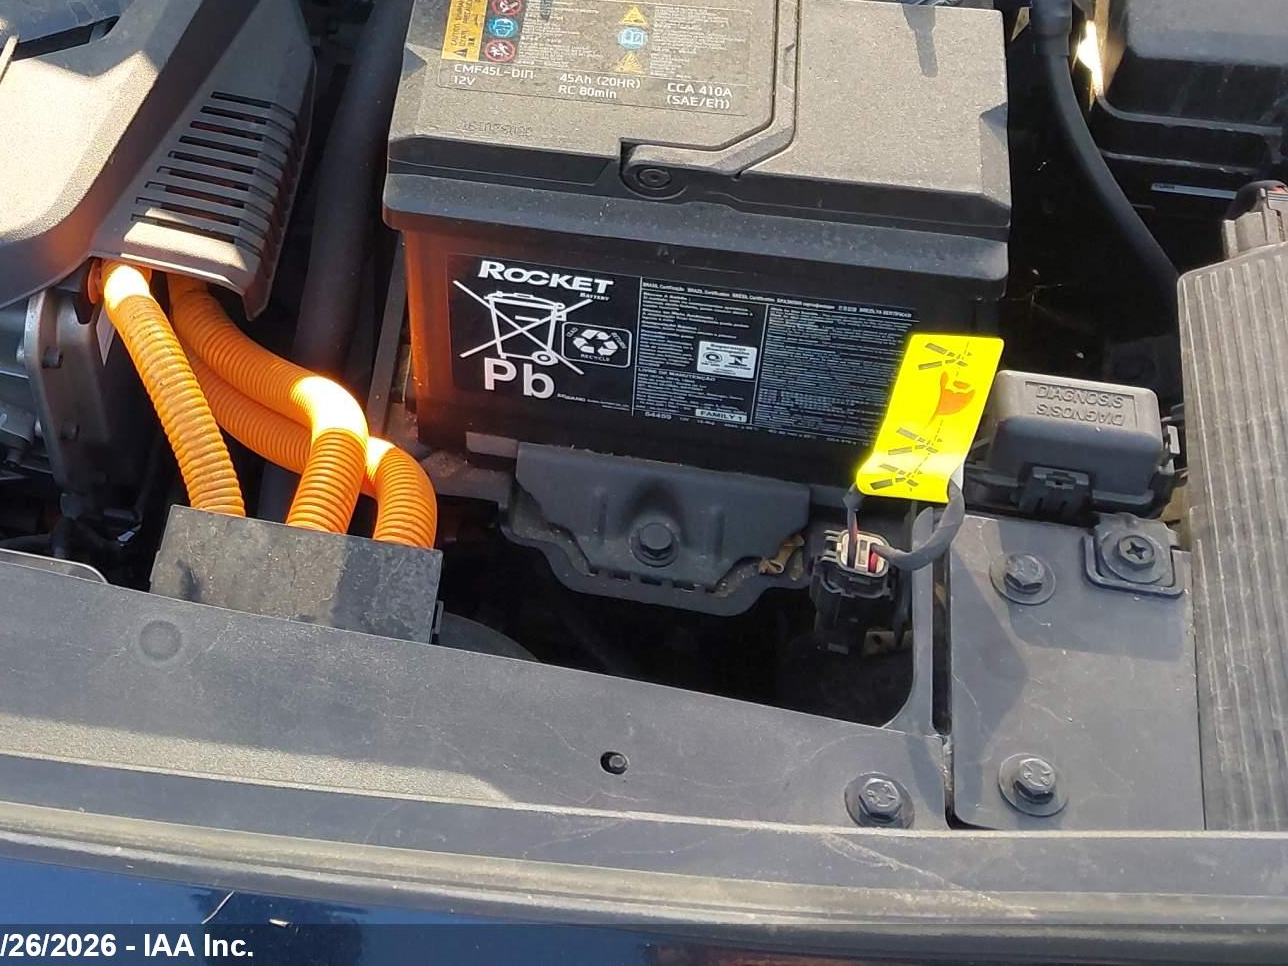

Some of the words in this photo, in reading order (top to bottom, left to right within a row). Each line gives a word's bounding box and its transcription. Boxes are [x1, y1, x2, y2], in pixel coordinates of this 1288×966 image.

[454, 64, 534, 79] CMF45L-DIN
[454, 76, 476, 86] 12V
[559, 73, 592, 85] 45Ah
[597, 76, 641, 89] (20HR)
[558, 85, 576, 95] RC
[579, 87, 617, 99] 80min
[667, 83, 695, 94] CCA
[698, 85, 733, 98] 410A
[667, 94, 730, 109] (SAE/EN)
[478, 260, 614, 294] ROCKET
[580, 292, 610, 301] BATTERY
[580, 353, 611, 362] RECYCLE
[484, 357, 555, 399] Pb
[1035, 384, 1124, 409] DIAGNOSIS
[700, 410, 736, 421] FAMILY
[1036, 403, 1125, 426] DIAGNOSIS
